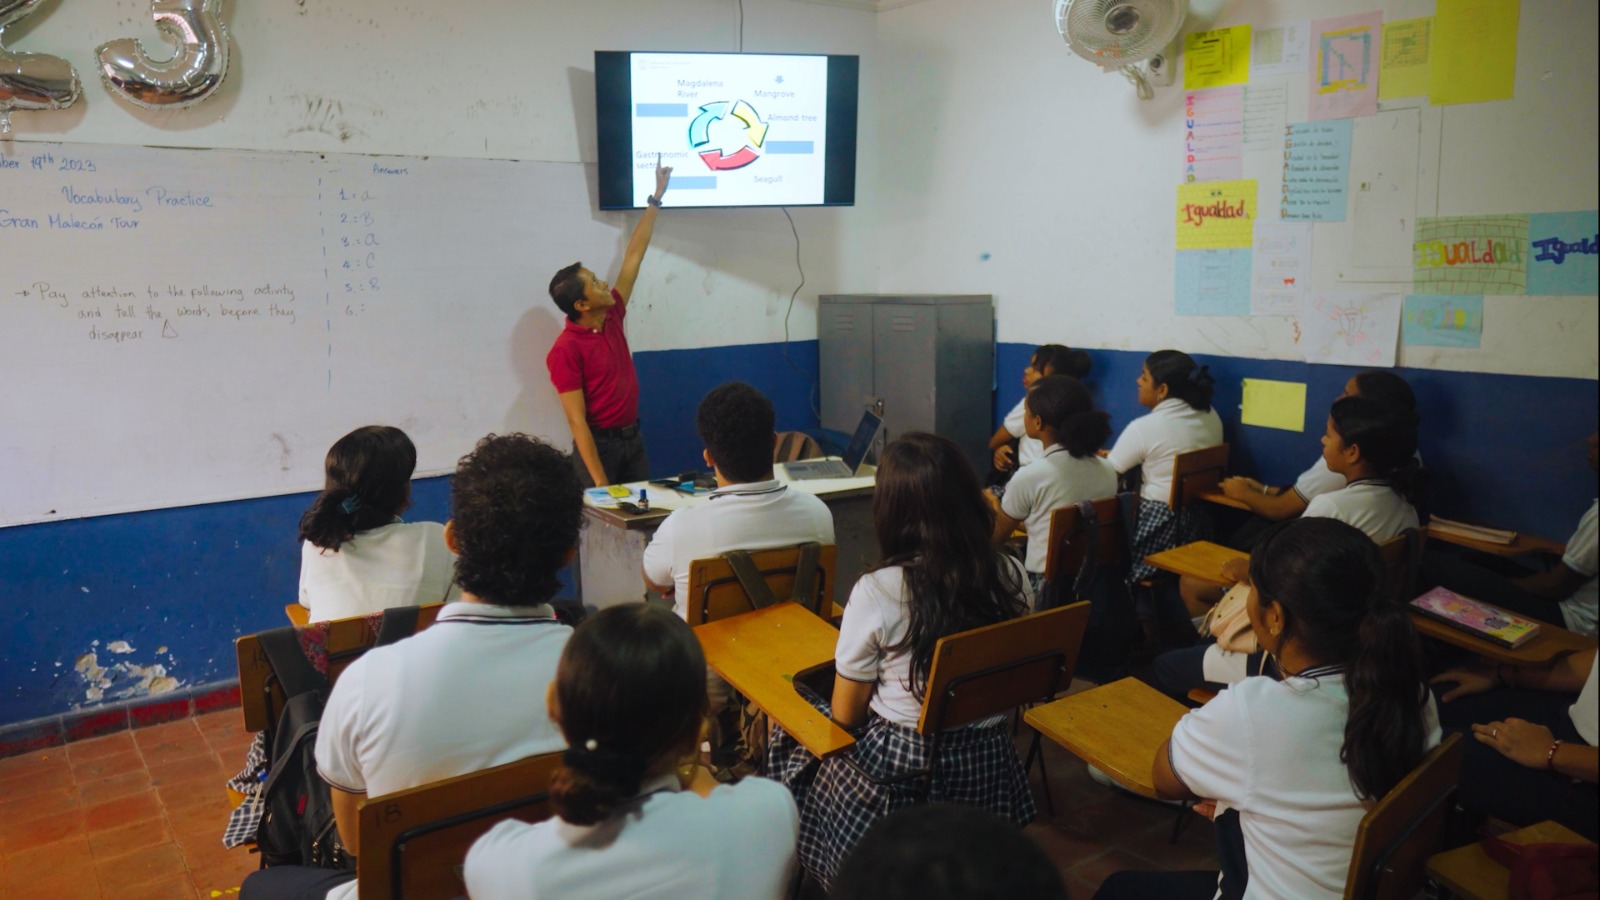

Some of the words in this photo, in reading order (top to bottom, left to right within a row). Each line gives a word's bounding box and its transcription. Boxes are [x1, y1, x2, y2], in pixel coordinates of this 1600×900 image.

[677, 79, 723, 88] Magdalena
[677, 90, 698, 98] River
[754, 90, 795, 98] Mangrove
[0, 152, 20, 169] ber
[59, 158, 97, 172] 2023
[373, 163, 409, 175] Answers
[753, 175, 783, 184] Seagull
[62, 185, 142, 213] Vocabulary
[146, 186, 213, 207] Practice
[0, 209, 38, 229] Gran
[48, 213, 103, 230] Malecón
[111, 216, 139, 229] Tour
[1182, 199, 1245, 227] Igualdad
[366, 251, 376, 269] C
[32, 281, 69, 308] Pay
[81, 285, 136, 299] attention
[147, 285, 159, 299] to
[168, 284, 185, 297] the
[191, 284, 244, 300] following
[254, 283, 295, 300] activity
[77, 307, 101, 320] and
[115, 304, 135, 318] tell
[145, 304, 162, 320] the
[220, 303, 261, 320] before
[269, 303, 296, 324] they
[89, 324, 144, 343] disappear
